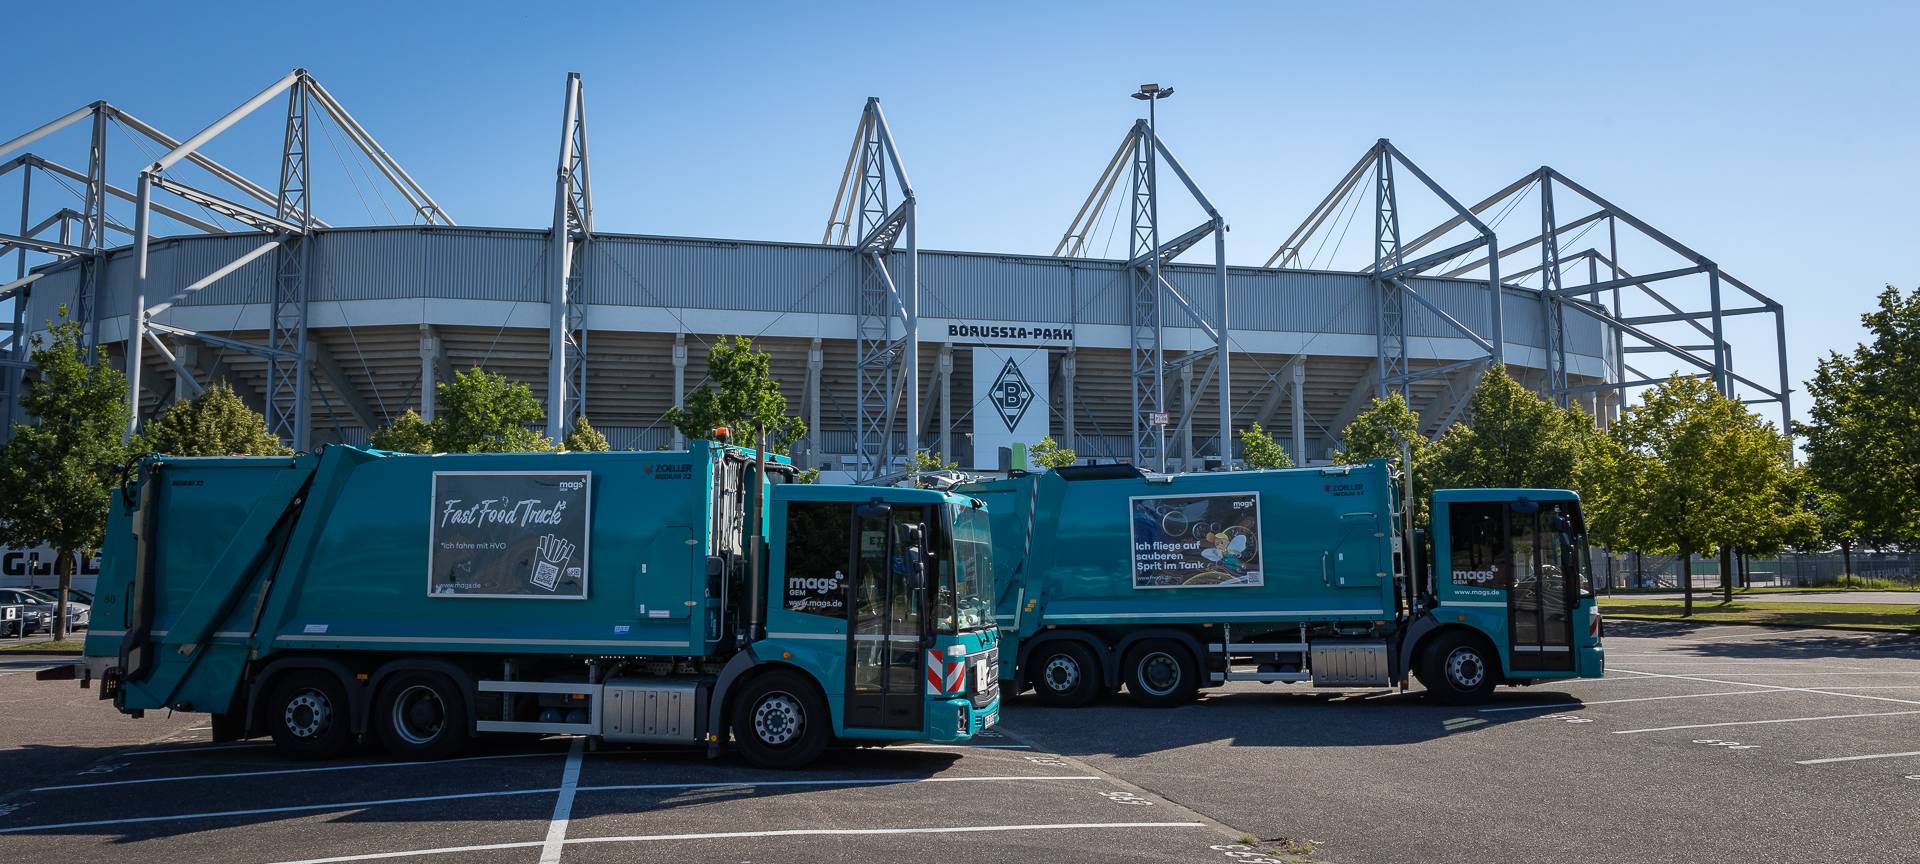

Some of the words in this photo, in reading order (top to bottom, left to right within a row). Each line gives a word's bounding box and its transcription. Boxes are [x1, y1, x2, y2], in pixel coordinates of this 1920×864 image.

[948, 325, 1073, 340] BORUSSIA-PARK
[656, 463, 692, 472] ZOELLER
[559, 481, 583, 491] mags
[1233, 501, 1253, 509] mags
[441, 499, 479, 528] Fast
[477, 499, 520, 528] Food
[456, 542, 475, 550] fahre
[476, 542, 489, 550] mit
[489, 542, 507, 550] HVO
[1135, 542, 1151, 551] Ich
[1153, 541, 1181, 552] fliege
[1183, 540, 1201, 550] auf
[1136, 552, 1184, 561] sauberen
[1137, 562, 1162, 572] Sprit
[1164, 562, 1177, 570] im
[1179, 561, 1205, 570] Tank
[1453, 570, 1494, 583] mags
[789, 577, 838, 595] mags
[1454, 589, 1500, 597] www.mags.de
[789, 599, 843, 608] www.mags.de
